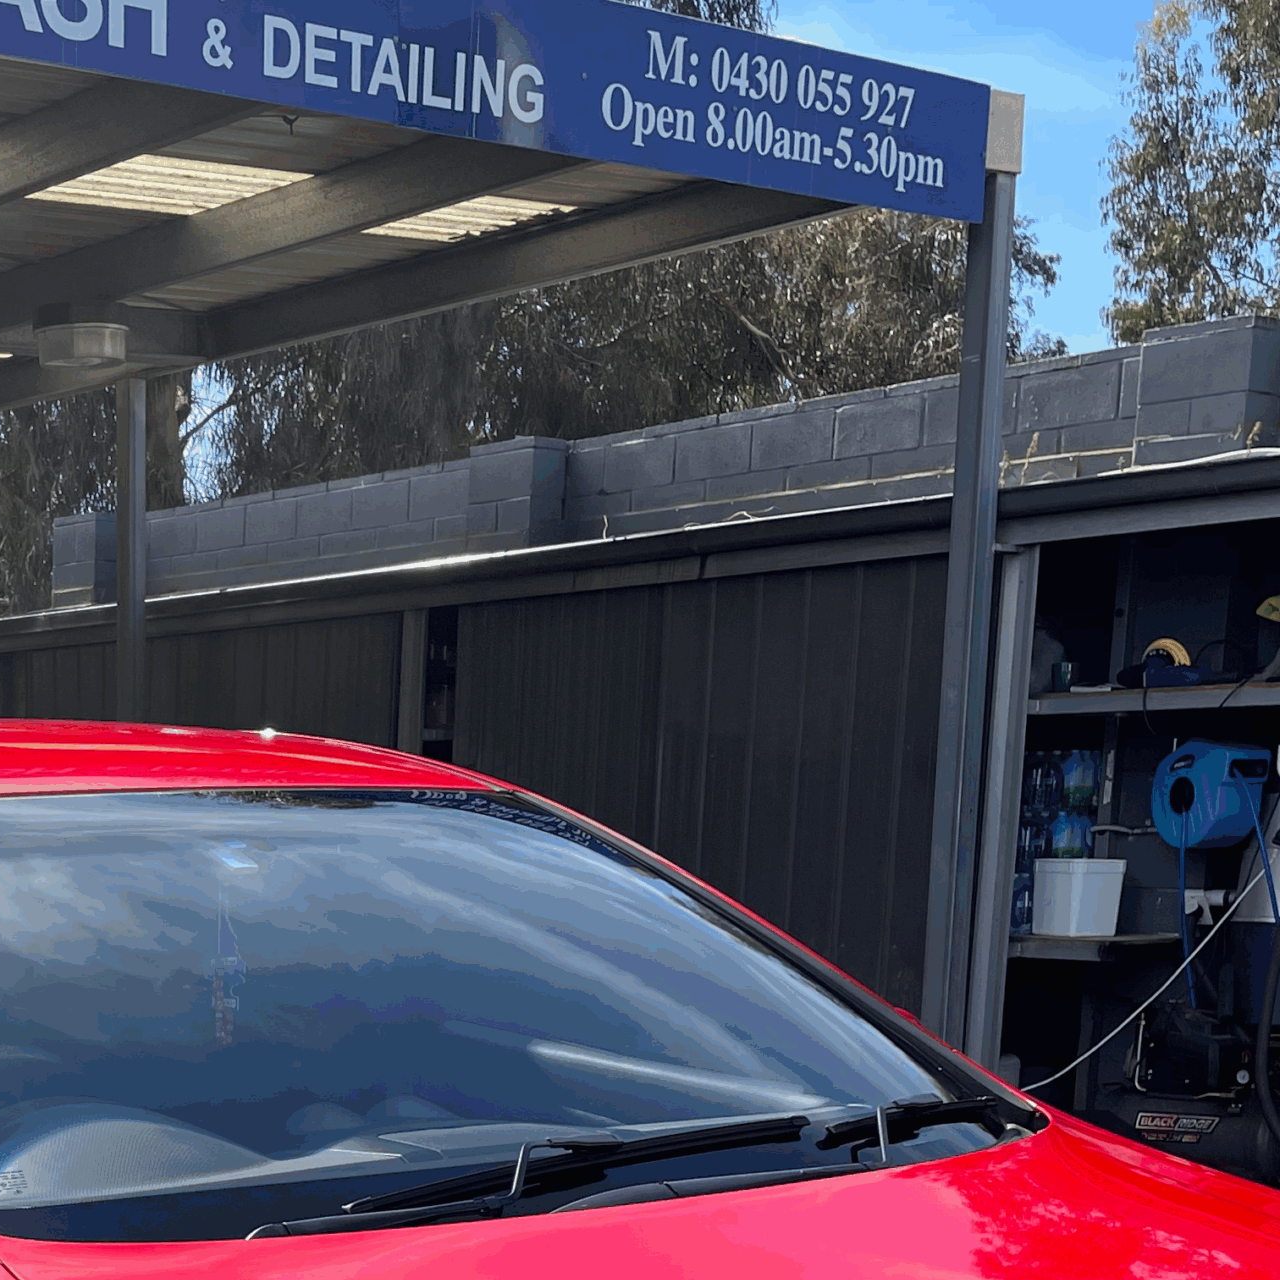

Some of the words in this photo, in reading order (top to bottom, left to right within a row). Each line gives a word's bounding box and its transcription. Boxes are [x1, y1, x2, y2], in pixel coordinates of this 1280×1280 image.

[202, 18, 234, 70] &
[263, 15, 545, 124] DETAILING
[644, 30, 699, 88] M:
[711, 47, 788, 104] 0430
[797, 64, 854, 117] 055
[861, 78, 916, 129] 927
[601, 83, 696, 147] Open
[705, 102, 945, 193] 8.00am-5.30pm
